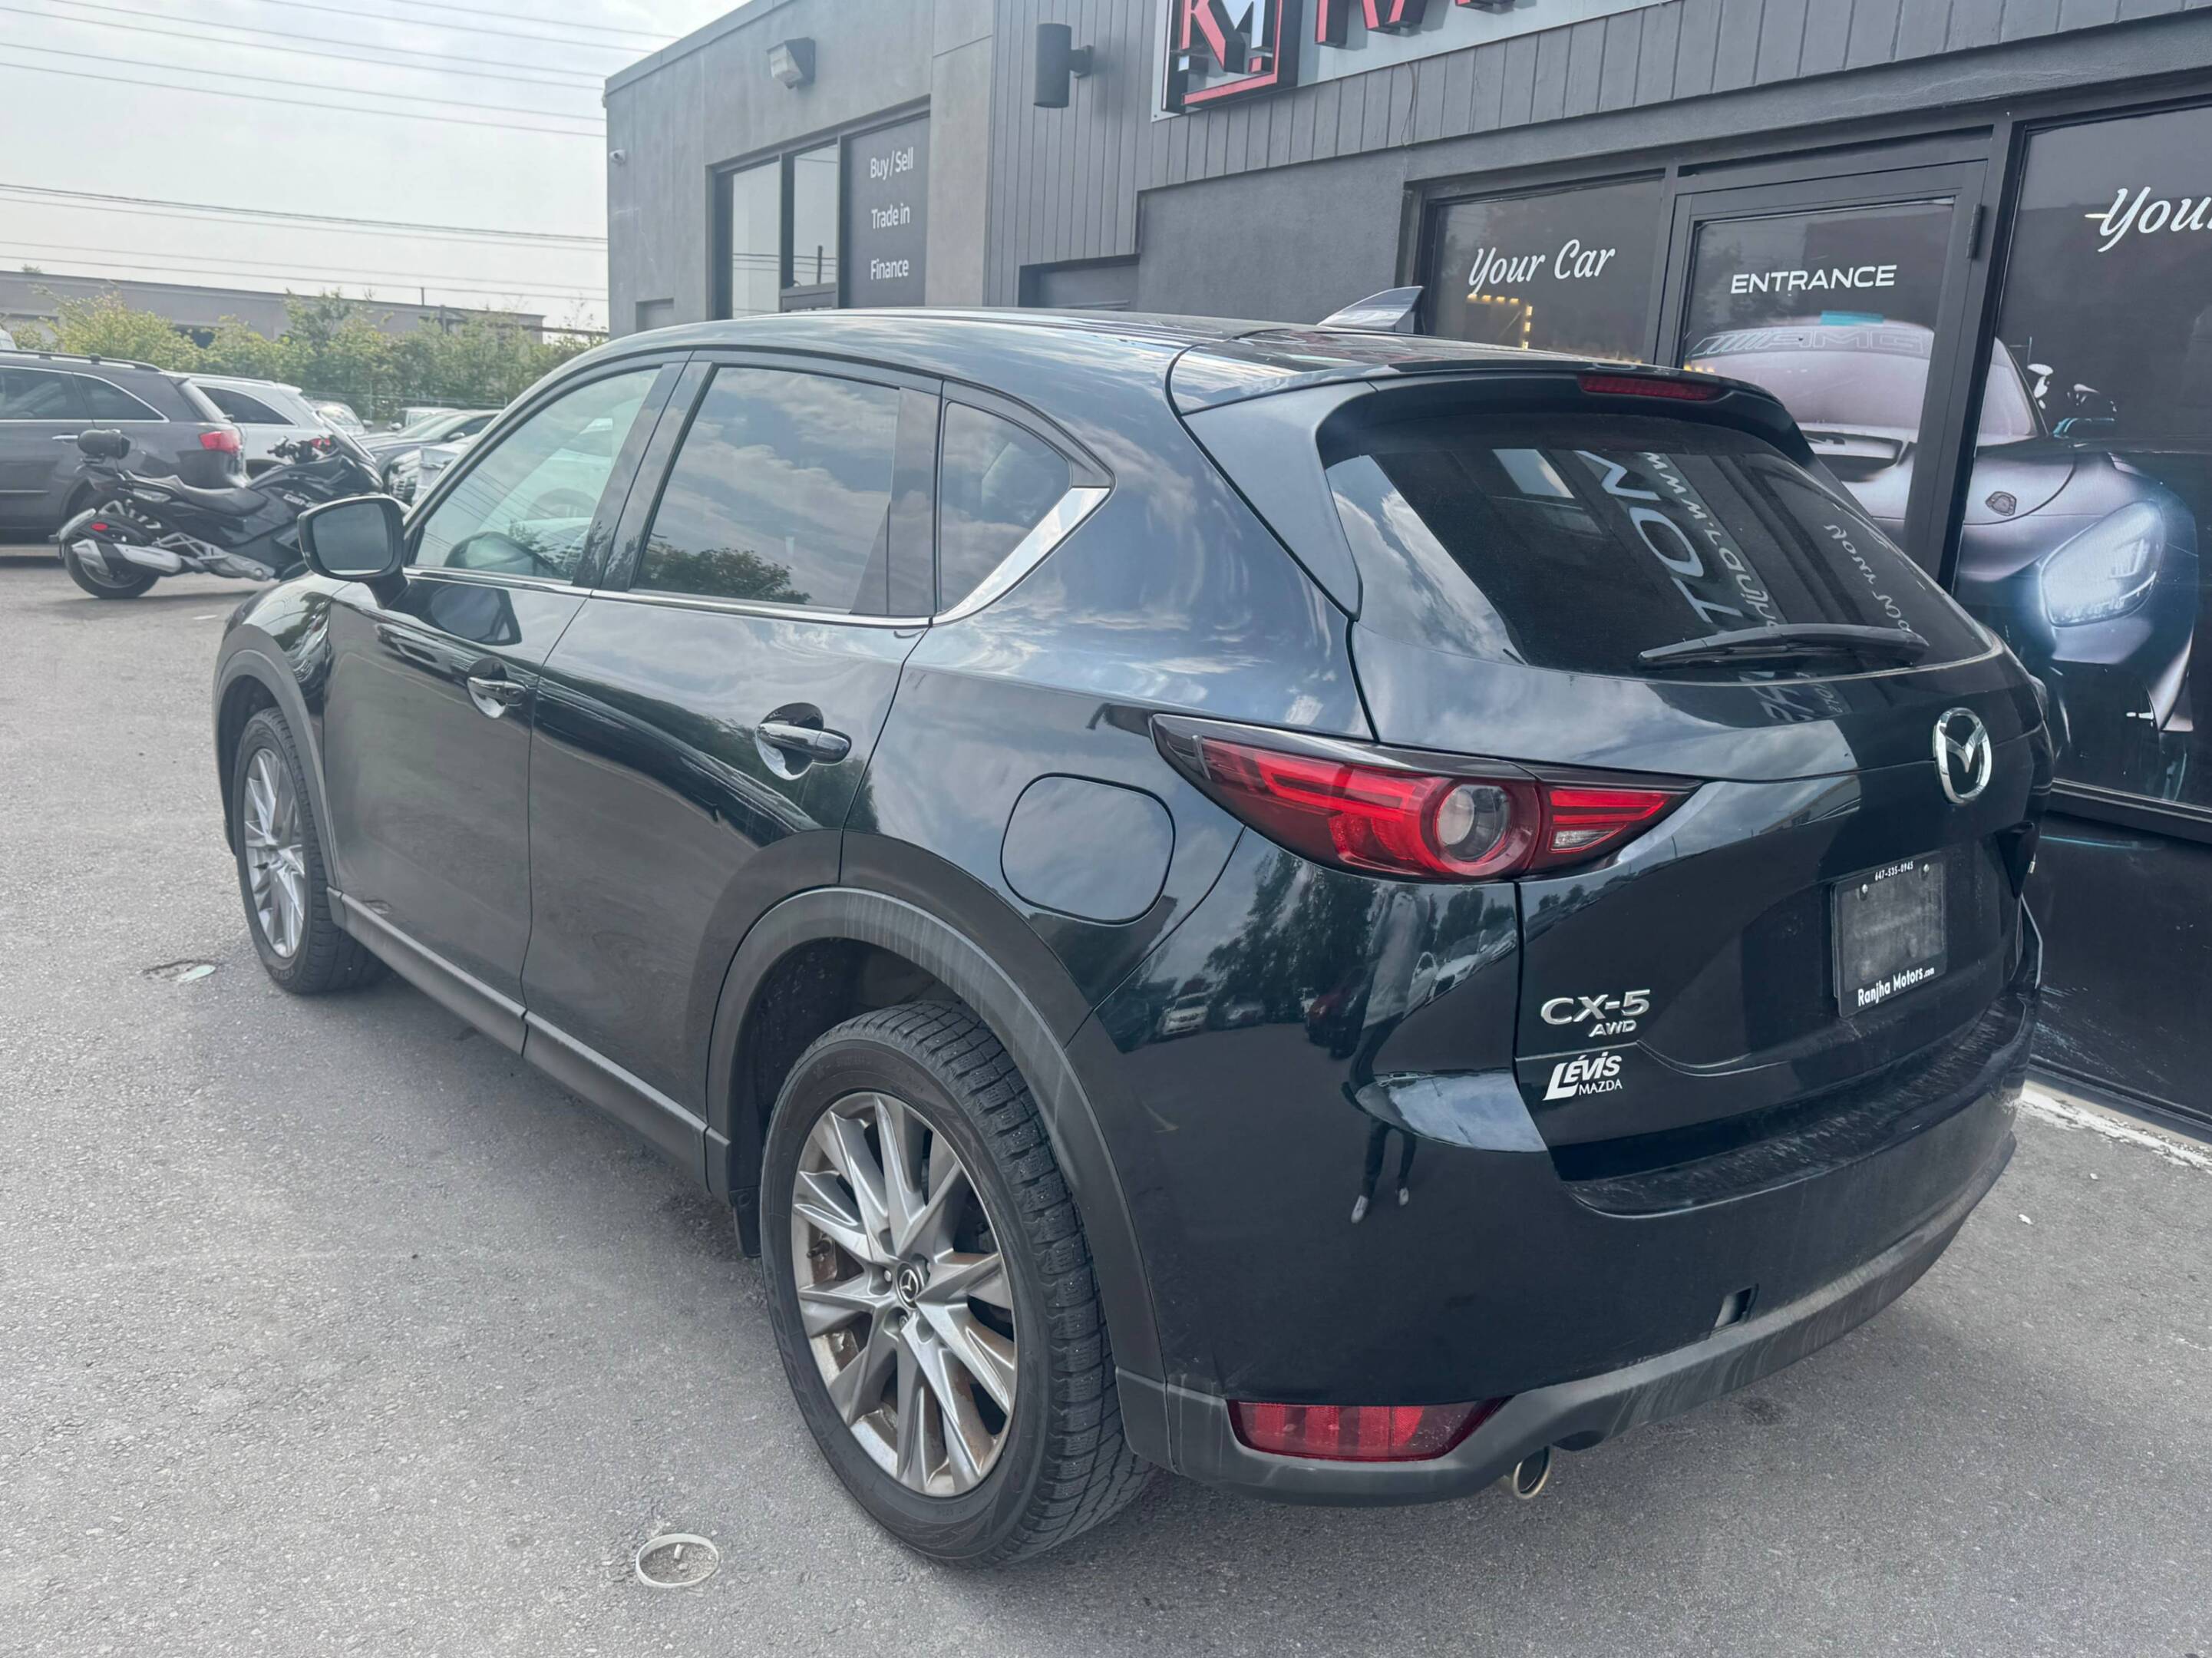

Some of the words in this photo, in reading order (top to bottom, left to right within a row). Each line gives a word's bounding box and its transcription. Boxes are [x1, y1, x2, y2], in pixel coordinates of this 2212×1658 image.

[871, 204, 899, 229] Trade
[900, 203, 910, 224] in
[2097, 186, 2212, 252] You
[870, 258, 909, 280] Finance
[1468, 246, 1546, 296] Your
[1553, 239, 1616, 279] Car
[1731, 265, 1897, 294] ENTRANCE
[1874, 860, 1914, 881] 647-535-0945
[1857, 980, 1890, 1006] Ranjha
[1540, 989, 1651, 1025] CX-5
[1588, 1019, 1637, 1037] AWD
[1578, 1078, 1623, 1096] MAZDA
